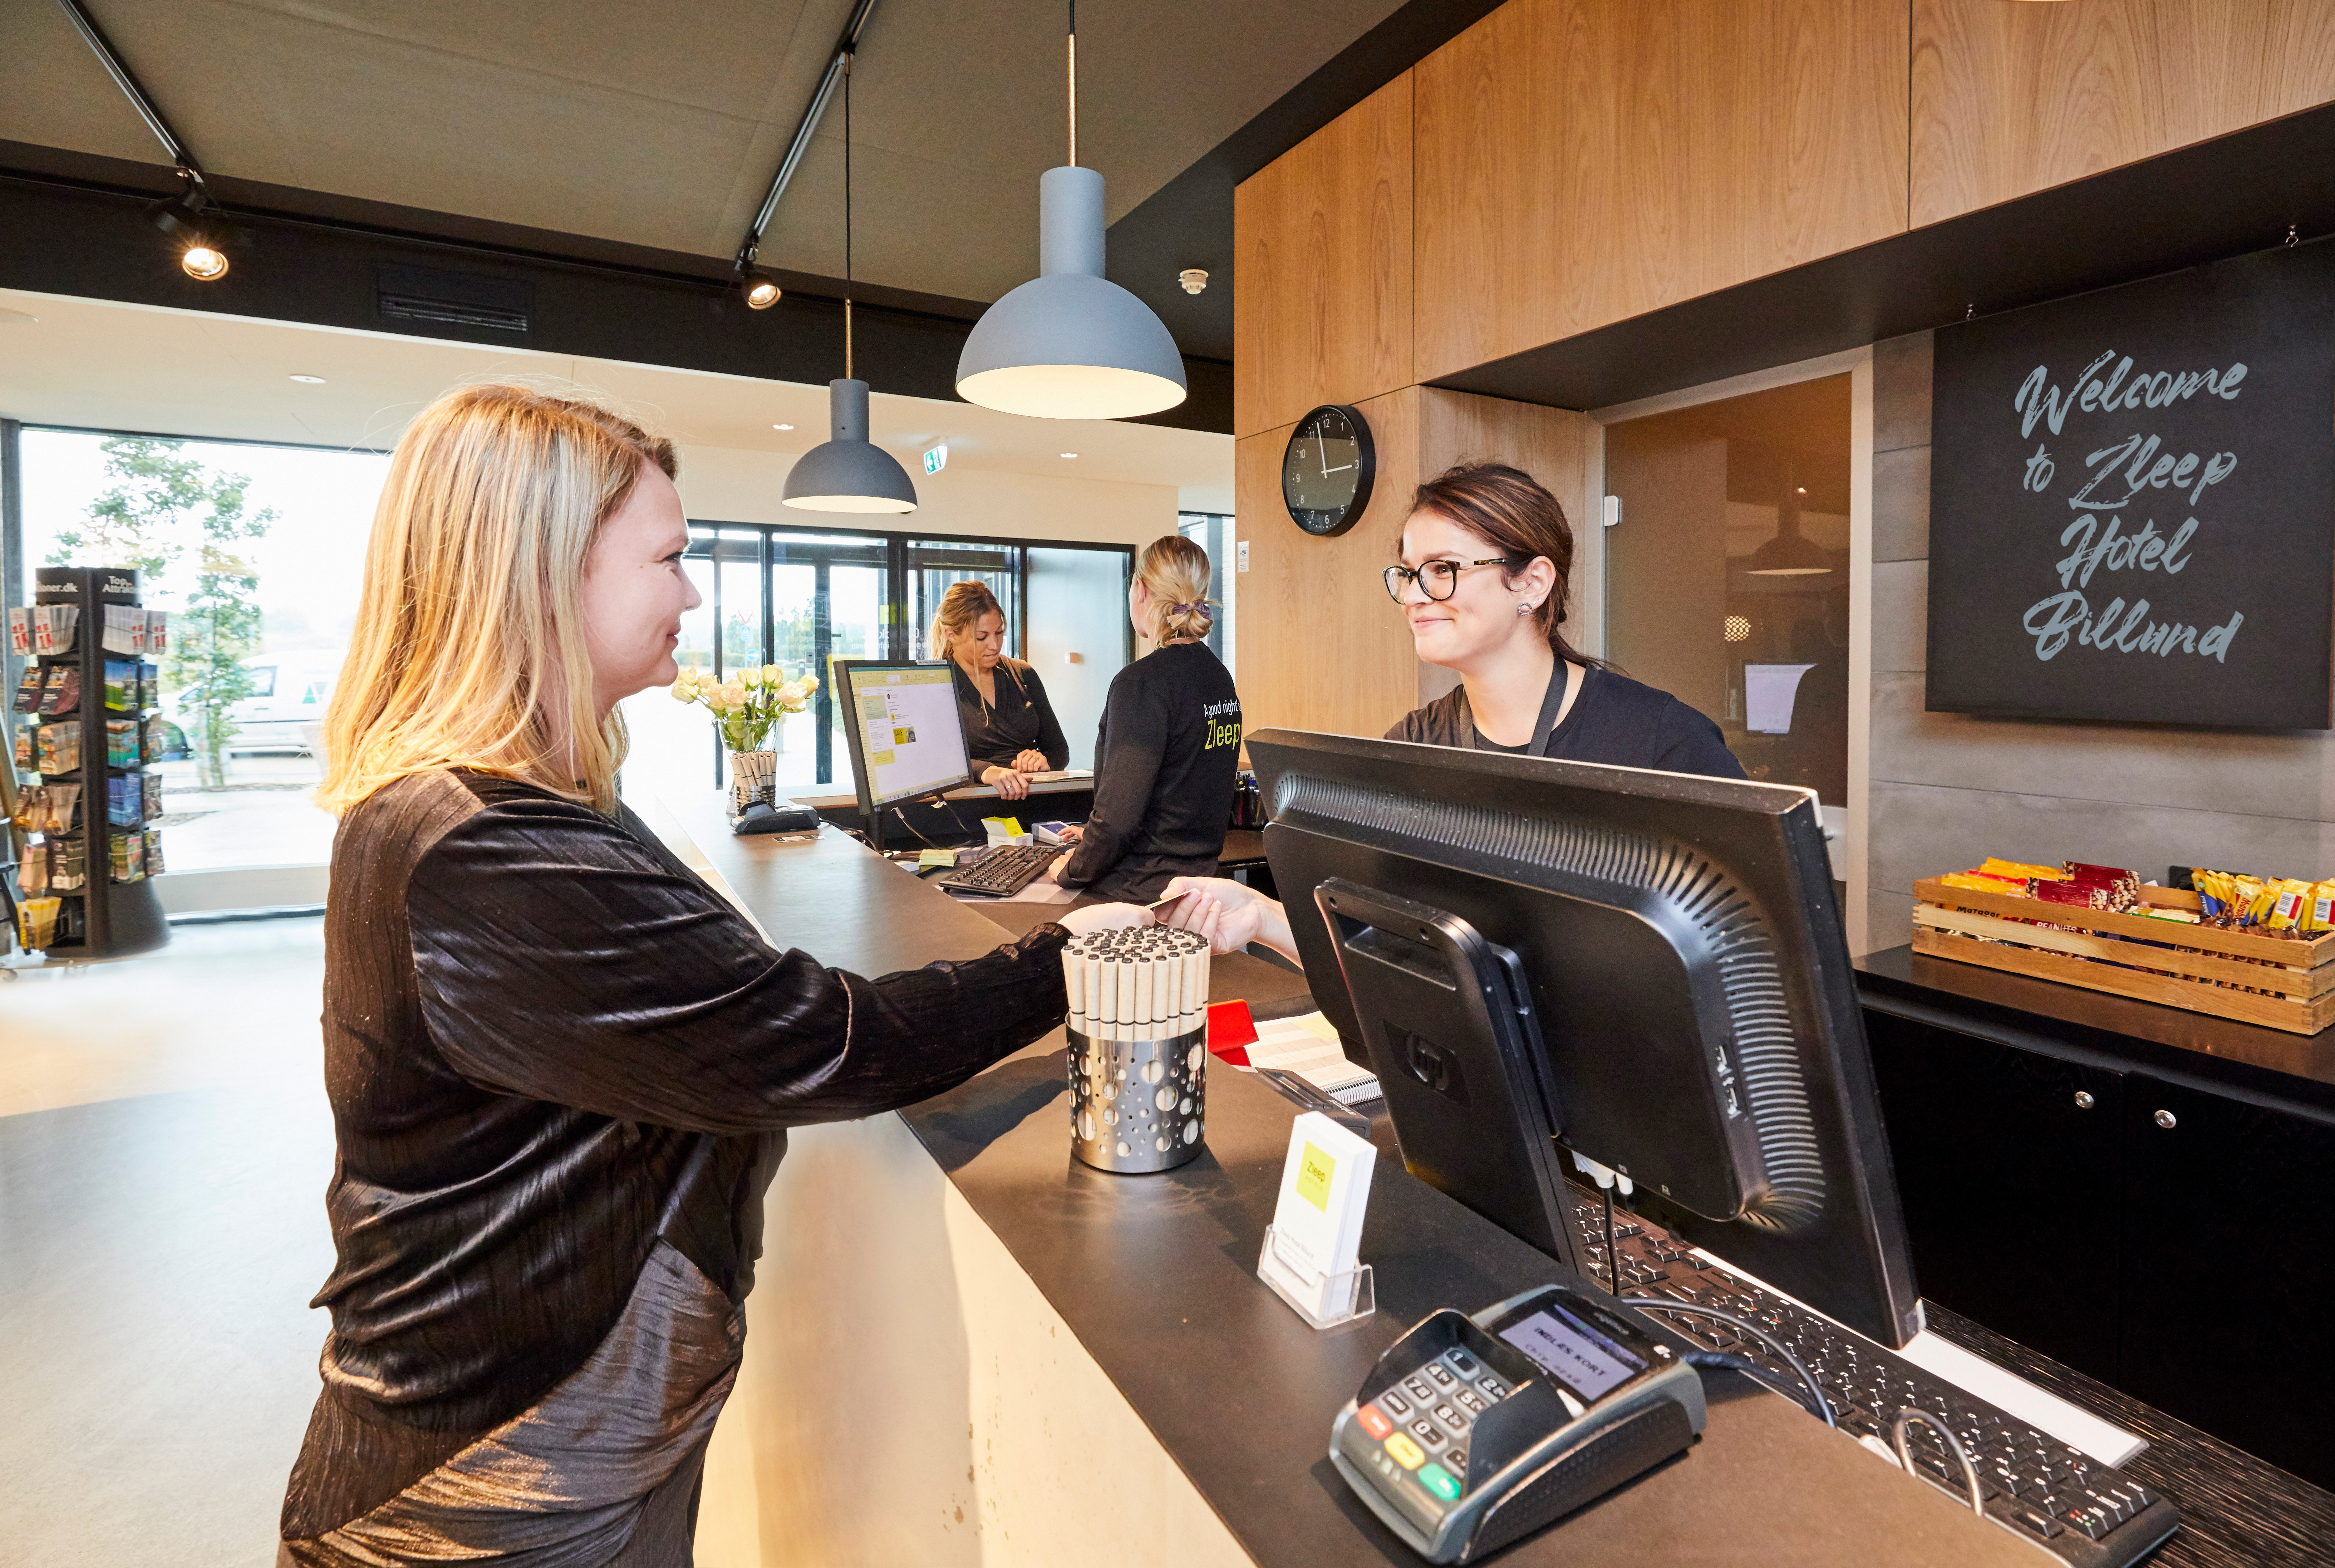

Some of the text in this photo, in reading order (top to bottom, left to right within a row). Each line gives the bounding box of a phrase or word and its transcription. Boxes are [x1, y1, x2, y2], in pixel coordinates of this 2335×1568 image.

[2015, 349, 2248, 439] Welcome
[1323, 418, 1330, 428] 12
[1341, 422, 1344, 431] 1
[1309, 430, 1315, 439] 11
[1350, 436, 1355, 446] 2
[1299, 449, 1306, 459] 10
[1355, 459, 1360, 469] 3
[2023, 433, 2237, 510] to Zleep
[1296, 473, 1300, 483] 9
[1352, 484, 1356, 493] 4
[1300, 495, 1304, 504] 8
[1311, 510, 1315, 520] 7
[1340, 505, 1345, 515] 5
[1325, 515, 1329, 524] 6
[2056, 513, 2199, 590] Hotel
[108, 576, 128, 586] Top
[2023, 589, 2244, 664] Billund
[1204, 703, 1209, 718] A
[1209, 700, 1221, 719] good
[1205, 719, 1240, 750] Zleep
[1307, 1160, 1326, 1183] Zleep
[1453, 1352, 1464, 1361] 1
[1428, 1365, 1442, 1376] 4
[1574, 1355, 1606, 1377] KORT
[1408, 1378, 1422, 1388] 7
[1482, 1378, 1498, 1390] 2
[1460, 1391, 1476, 1404] 5
[1437, 1407, 1453, 1419] 8
[1415, 1421, 1431, 1435] 0
